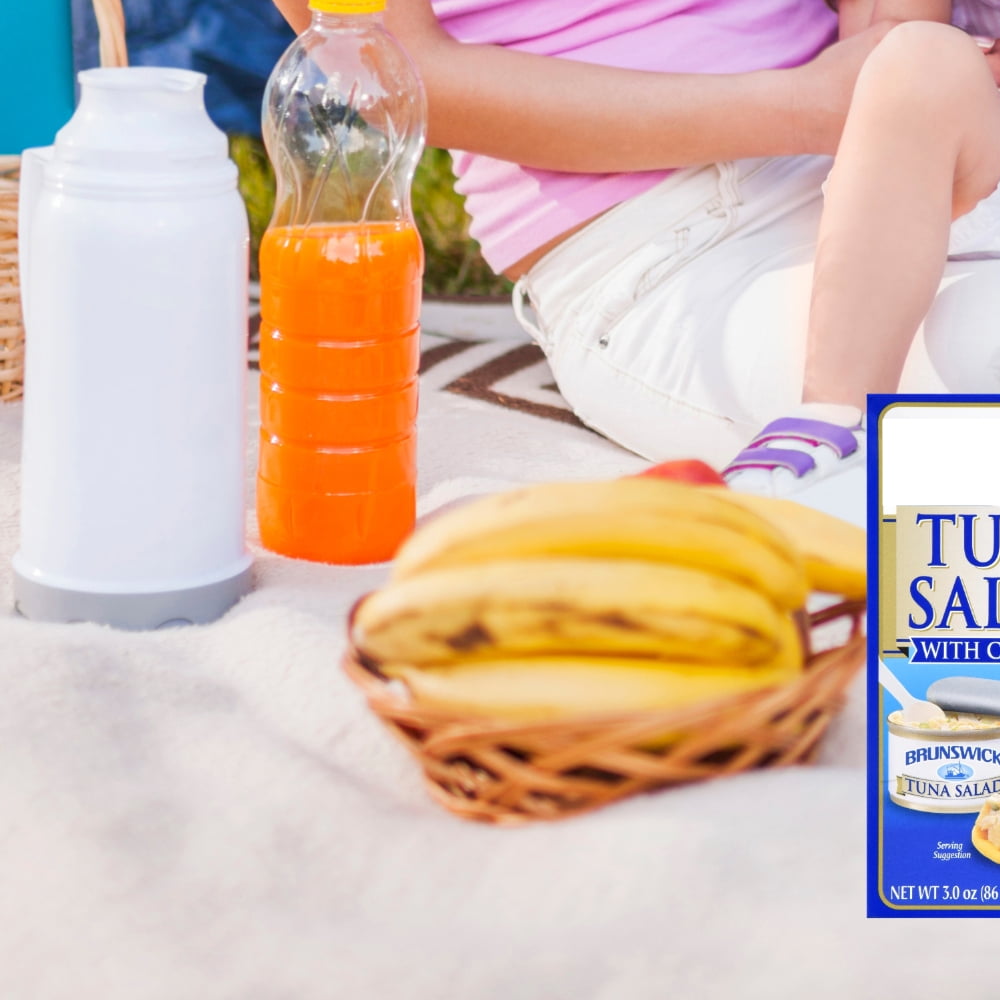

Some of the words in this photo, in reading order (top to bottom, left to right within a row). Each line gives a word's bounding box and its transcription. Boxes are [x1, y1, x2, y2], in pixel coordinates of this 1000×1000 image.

[920, 642, 980, 660] WITH
[905, 778, 951, 797] TUNA
[936, 841, 963, 851] Serving
[932, 850, 971, 861] Suggestion
[890, 885, 915, 900] NET
[918, 885, 940, 900] WT
[942, 885, 960, 900] 3.0
[963, 889, 977, 900] oz
[980, 885, 999, 903] (86
